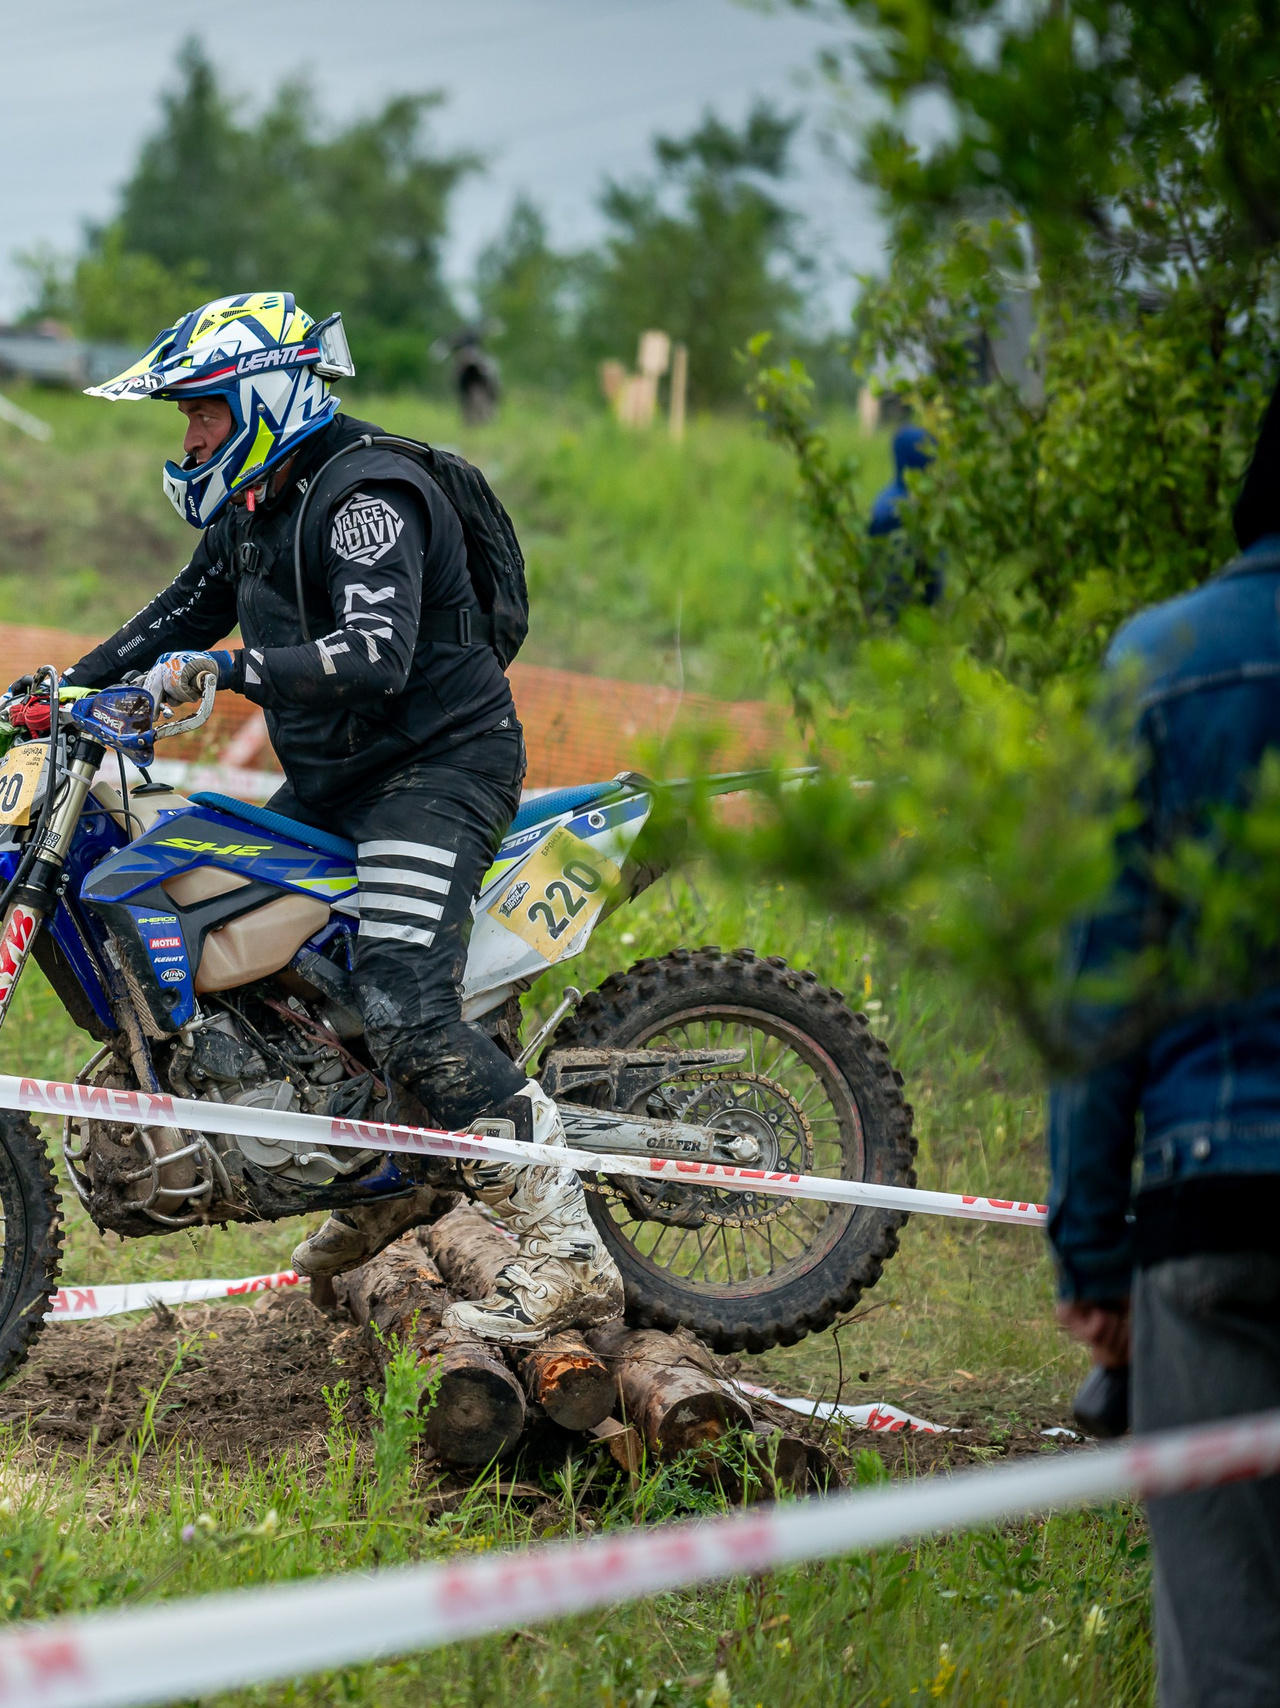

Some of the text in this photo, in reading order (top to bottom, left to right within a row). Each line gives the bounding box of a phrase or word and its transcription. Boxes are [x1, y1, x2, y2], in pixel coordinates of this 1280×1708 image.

[236, 345, 305, 374] LEATT
[342, 505, 384, 531] RACE
[344, 520, 385, 553] DIV
[502, 830, 542, 852] 300
[541, 831, 565, 857] БРОНЗА
[527, 860, 602, 940] 220
[138, 916, 177, 924] SHERCO
[151, 938, 180, 948] MOTUL
[154, 955, 185, 963] KENNY
